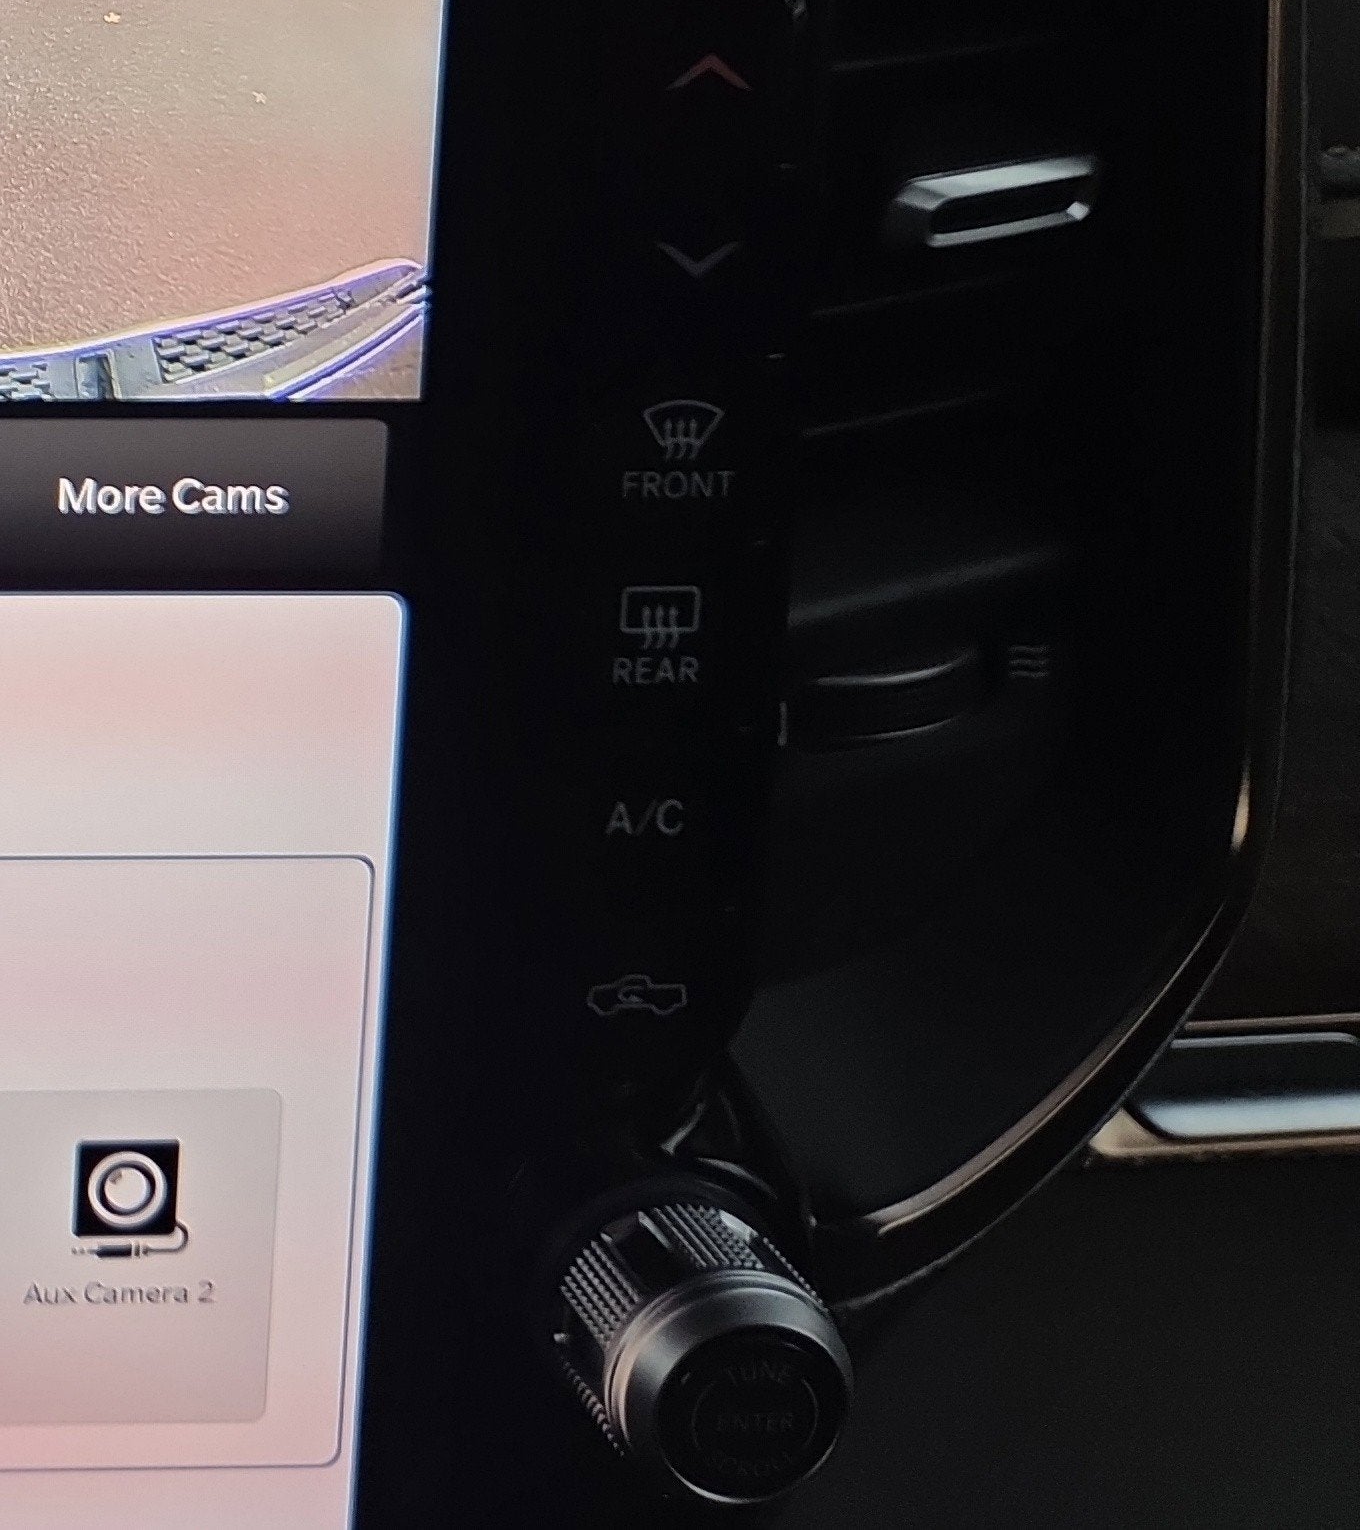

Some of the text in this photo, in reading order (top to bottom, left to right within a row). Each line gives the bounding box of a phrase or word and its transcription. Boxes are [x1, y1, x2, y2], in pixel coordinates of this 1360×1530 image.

[57, 477, 290, 514] More Cams
[622, 470, 735, 498] FRONT
[612, 657, 700, 684] REAR
[605, 798, 685, 836] A/C
[22, 1281, 215, 1306] Aux Camera 2
